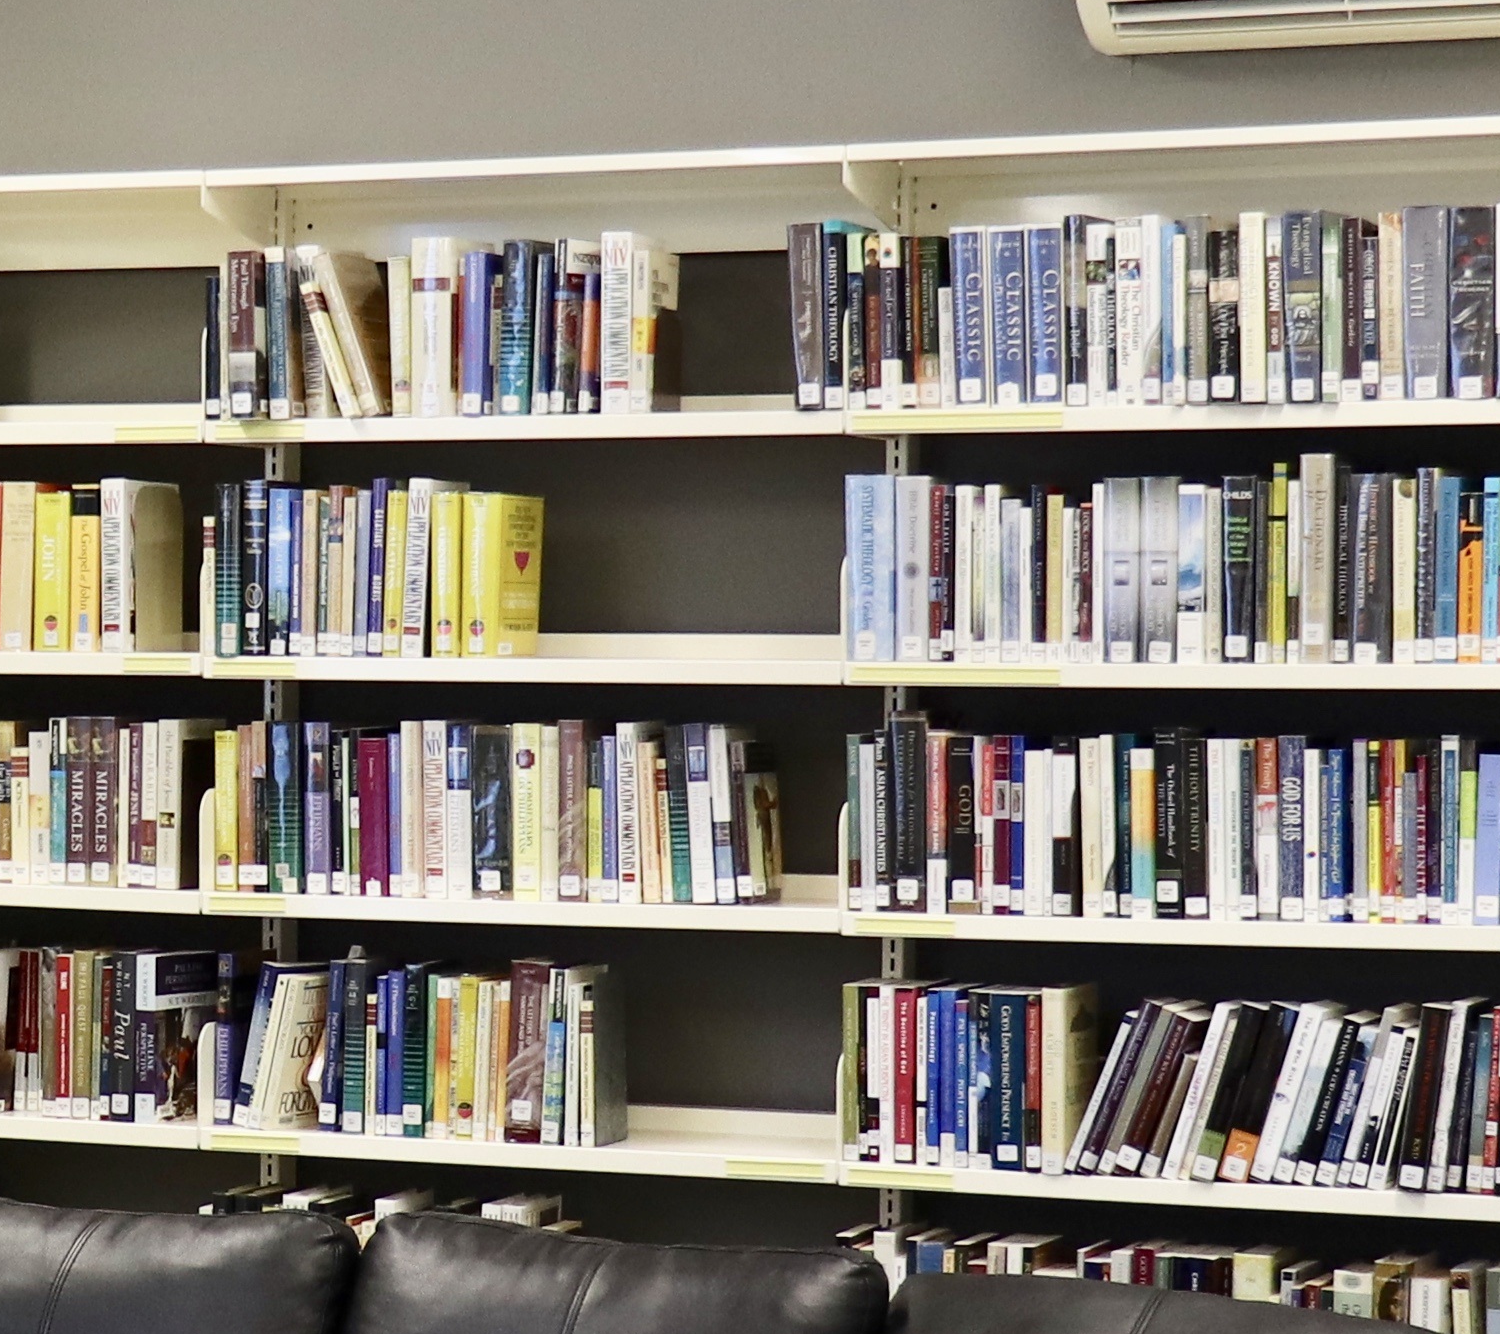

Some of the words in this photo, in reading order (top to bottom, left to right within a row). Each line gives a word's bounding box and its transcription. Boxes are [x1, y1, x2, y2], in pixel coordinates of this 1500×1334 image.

[828, 247, 837, 303] CHRISTIAN
[1268, 261, 1280, 311] KNOWN
[829, 306, 838, 363] THEOLOGY
[965, 271, 983, 361] CLASSIC
[860, 485, 874, 536] SYSTEMATIC
[41, 534, 57, 582] JOHN
[860, 539, 874, 586] THEOLOGY
[69, 770, 85, 852] MIRACLES
[1283, 777, 1301, 802] GOD
[1283, 804, 1301, 826] FOR
[1283, 829, 1301, 841] US
